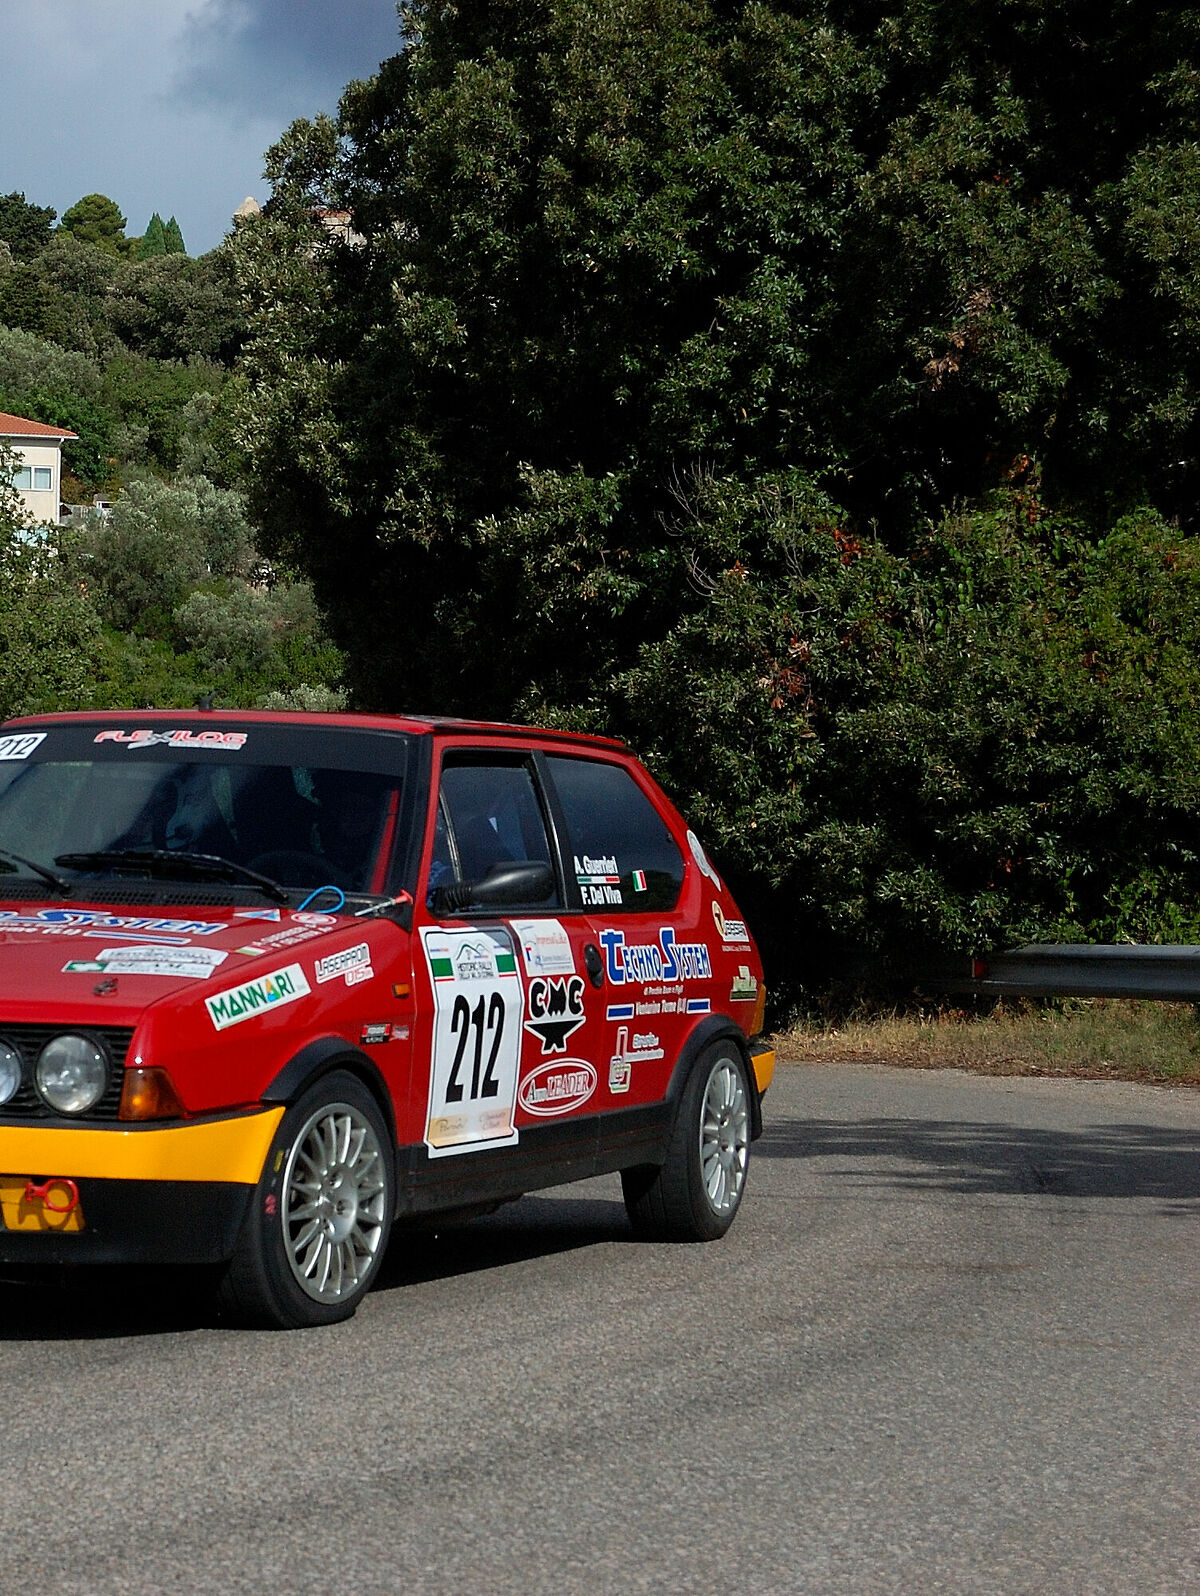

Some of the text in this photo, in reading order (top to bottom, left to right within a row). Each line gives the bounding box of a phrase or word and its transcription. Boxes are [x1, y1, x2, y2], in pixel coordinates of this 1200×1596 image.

[94, 730, 248, 749] FLEXILOG
[583, 855, 619, 874] Guerrieri
[581, 886, 623, 905] F. Del Viva
[6, 909, 228, 935] SYSTEM
[600, 928, 712, 984] TECHNO SYSTEM
[209, 971, 295, 1023] MANNARI
[530, 979, 584, 1018] CMC
[445, 992, 505, 1103] 212
